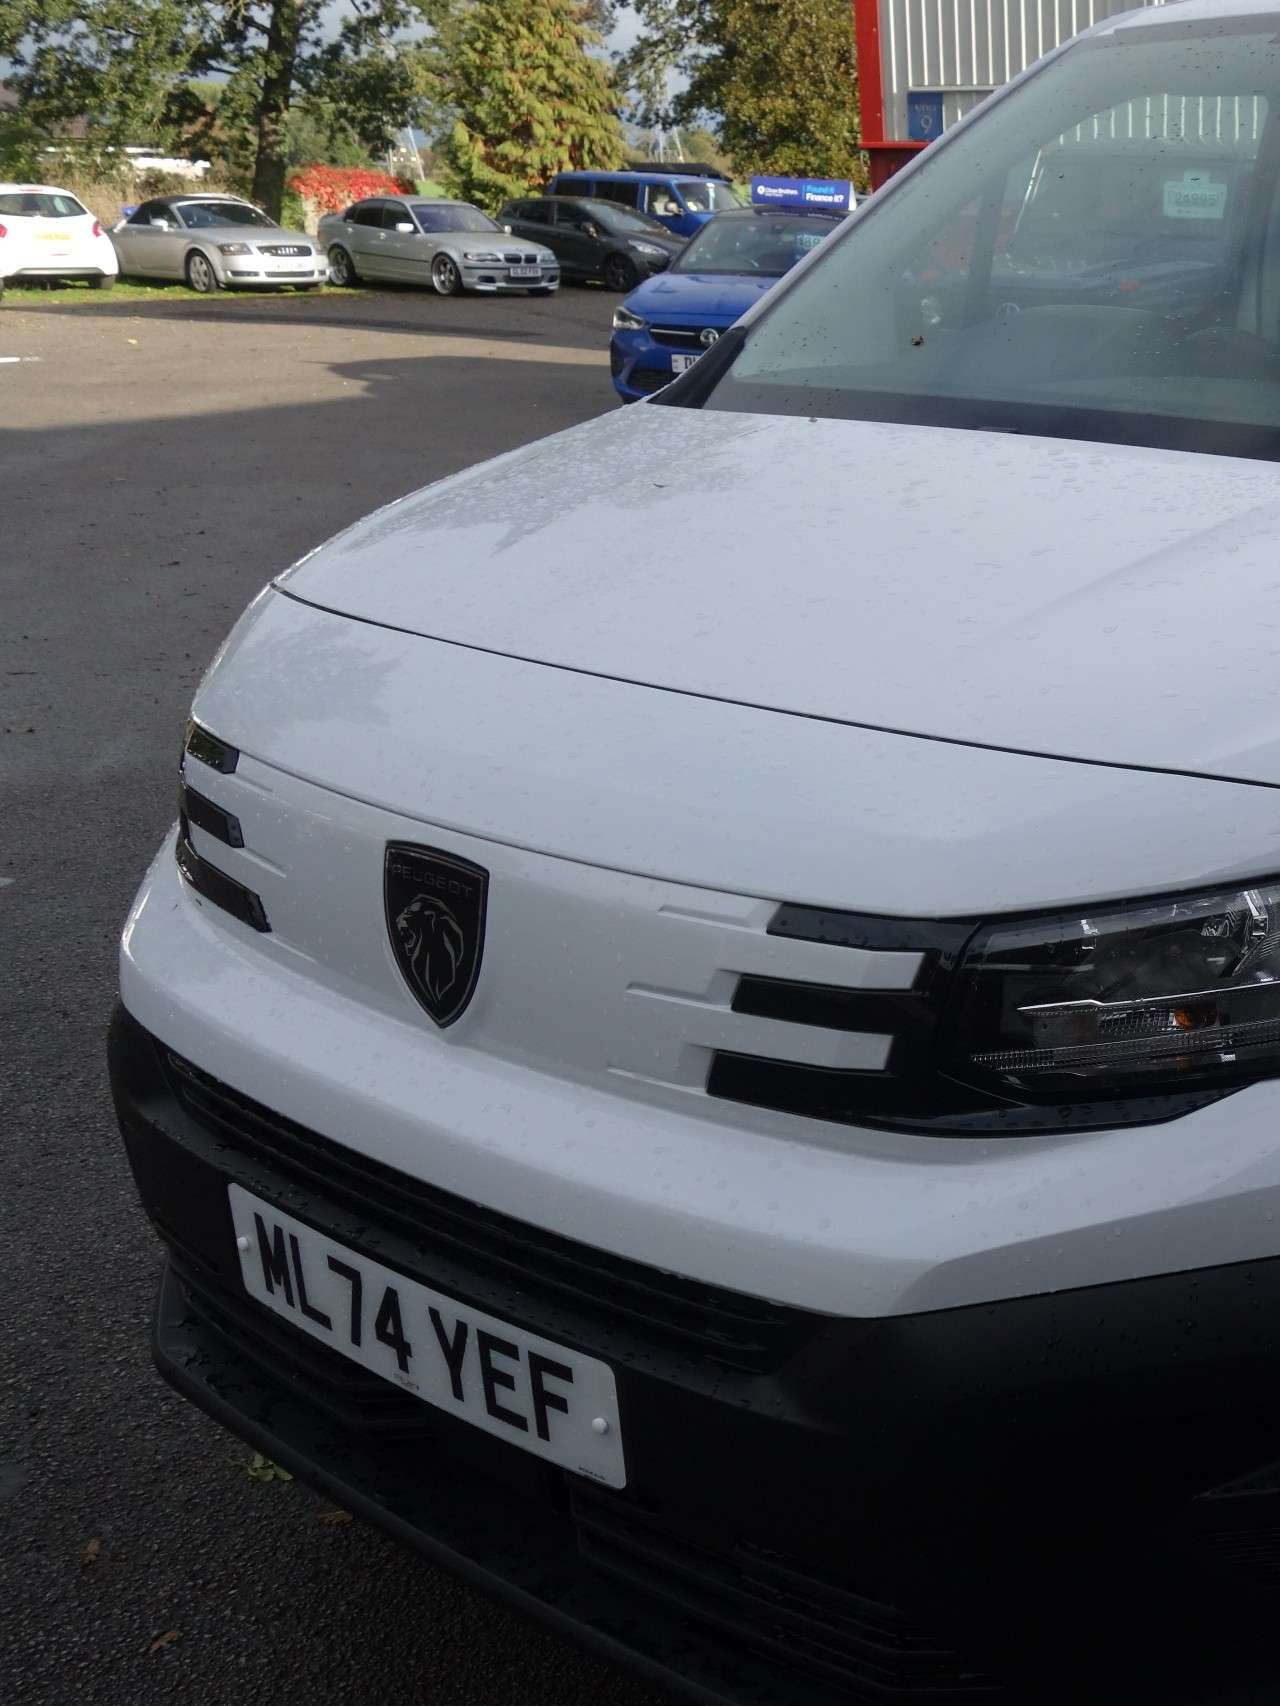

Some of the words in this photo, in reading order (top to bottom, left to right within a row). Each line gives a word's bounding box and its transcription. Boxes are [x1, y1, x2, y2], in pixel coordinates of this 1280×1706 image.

[806, 193, 833, 202] Finance
[392, 863, 473, 898] PEUGEOT
[254, 1211, 413, 1374] ML74
[428, 1306, 574, 1442] YEF
